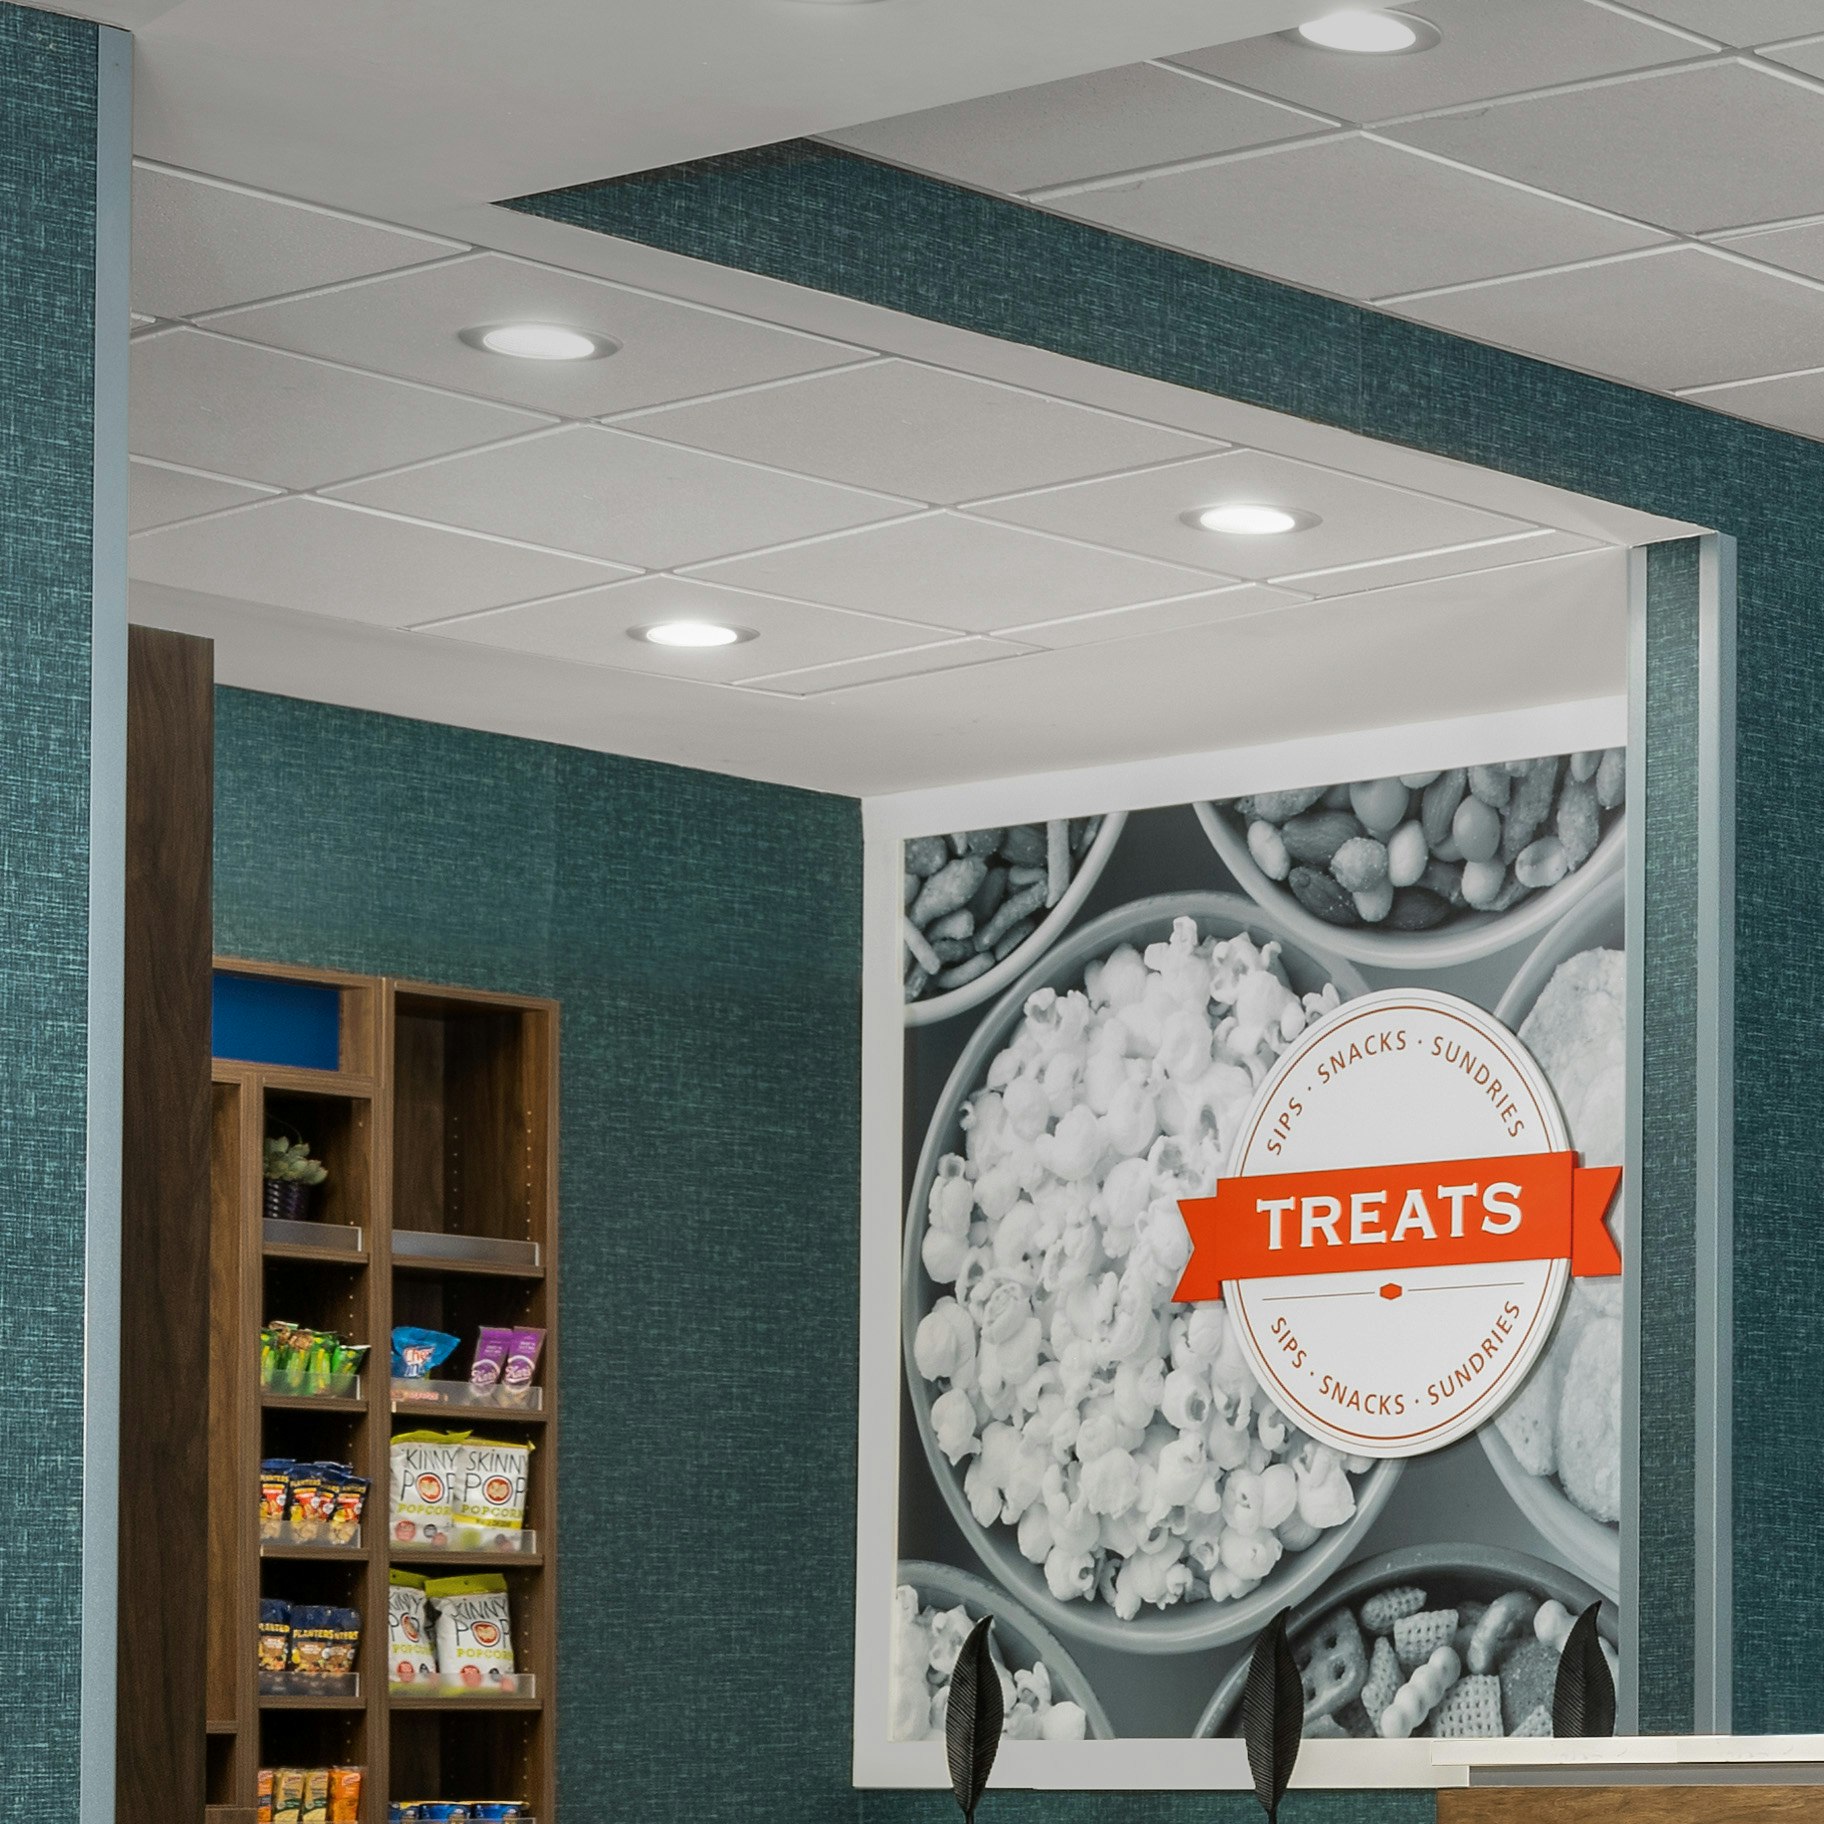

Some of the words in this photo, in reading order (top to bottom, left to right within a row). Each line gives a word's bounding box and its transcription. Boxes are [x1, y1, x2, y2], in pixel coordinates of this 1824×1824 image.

[1267, 1097, 1303, 1155] SIPS
[1317, 1030, 1406, 1084] SNACKS
[1431, 1036, 1525, 1137] SUNDRIES
[1255, 1181, 1523, 1251] TREATS
[1271, 1317, 1307, 1369] SIPS
[1319, 1375, 1405, 1415] SNACKS
[1427, 1301, 1520, 1406] SUNDRIES
[401, 1448, 460, 1471] KINNY
